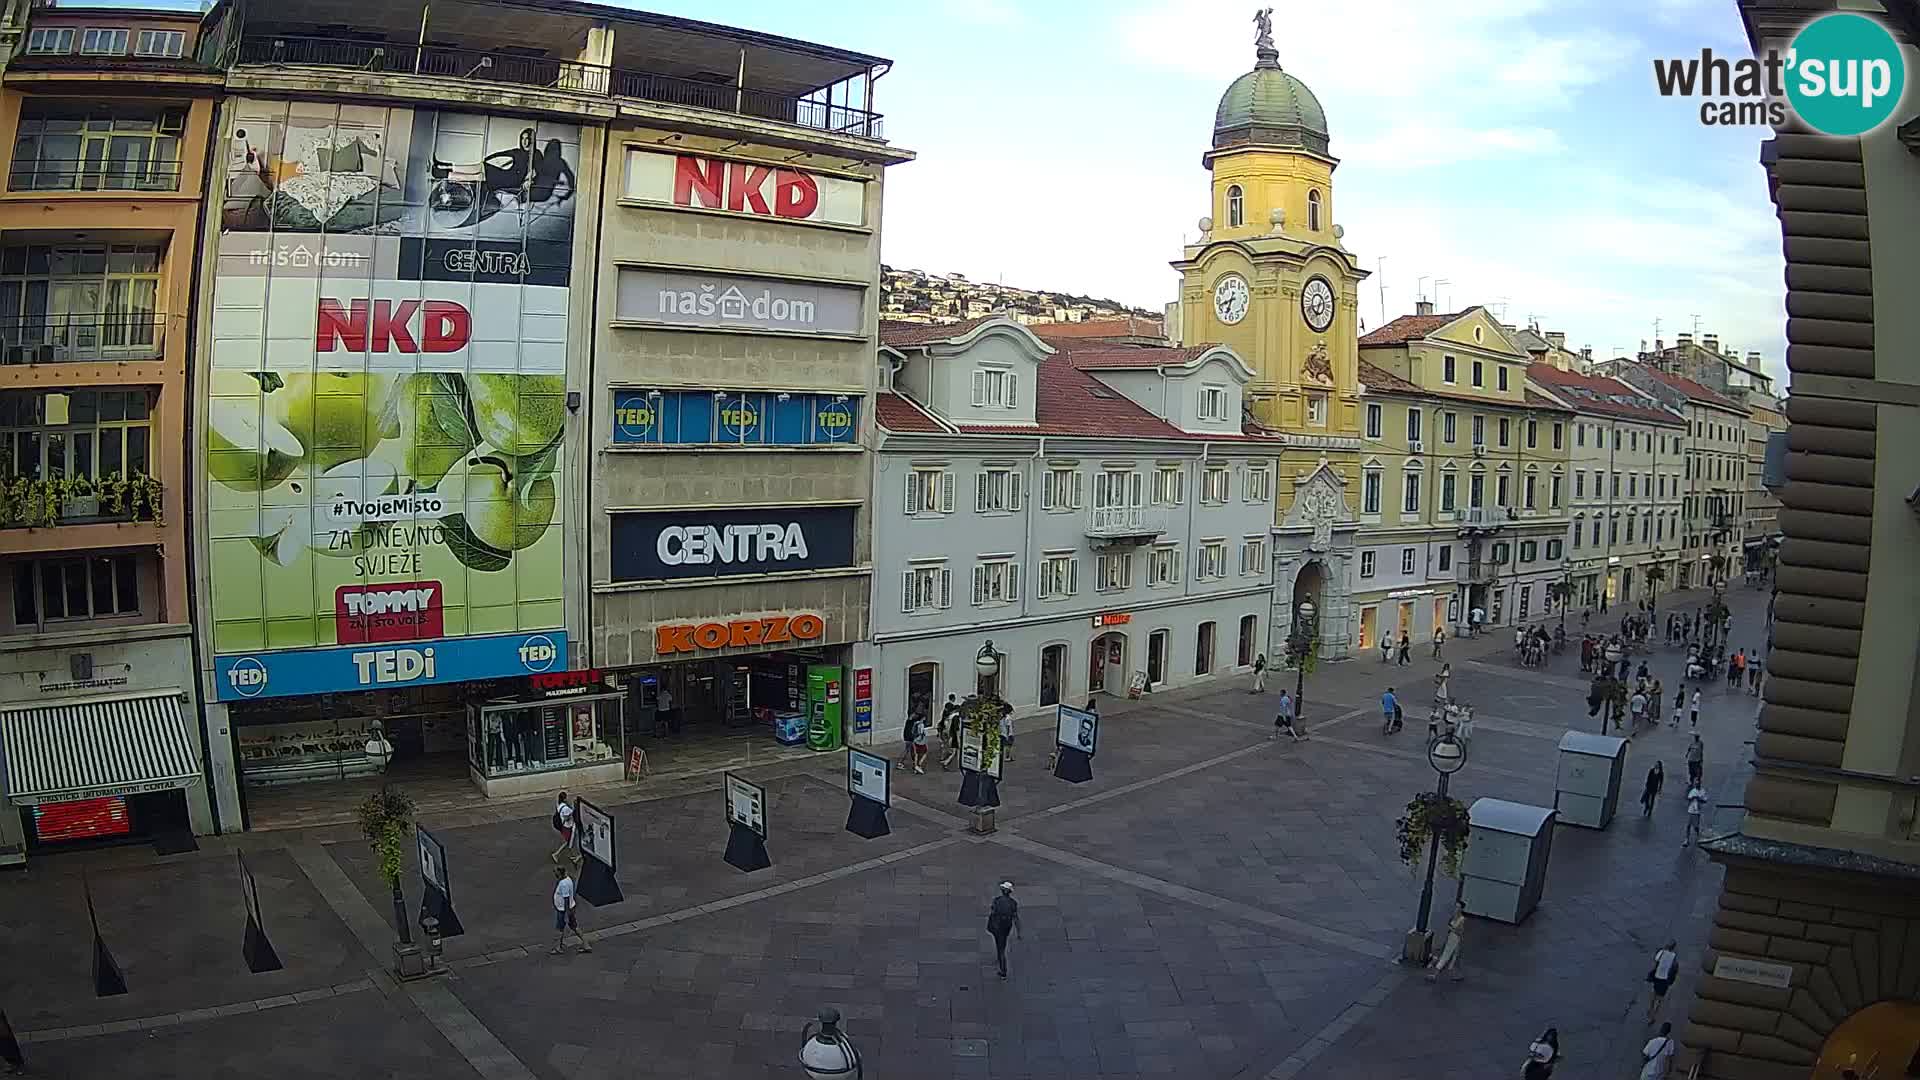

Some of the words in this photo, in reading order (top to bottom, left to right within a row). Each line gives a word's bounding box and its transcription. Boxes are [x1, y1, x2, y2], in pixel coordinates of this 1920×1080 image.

[673, 155, 819, 219] NKD
[314, 246, 360, 268] dom
[443, 249, 531, 275] CENTRA
[659, 284, 716, 316] naš
[753, 290, 815, 323] dom
[315, 298, 473, 354] NKD
[616, 409, 655, 425] TEDi
[722, 410, 758, 426] TEDi
[818, 412, 852, 427] TEDi
[333, 498, 442, 518] #TvojeMisto
[328, 530, 353, 550] ZA
[361, 525, 446, 549] DNEVNO
[657, 522, 809, 566] CENTRA
[354, 548, 421, 577] SVJEŽE
[344, 588, 434, 616] TOMMY
[656, 614, 824, 655] KORZO
[352, 647, 435, 685] TEDi
[518, 645, 556, 663] TEDi
[228, 668, 268, 687] TEDi
